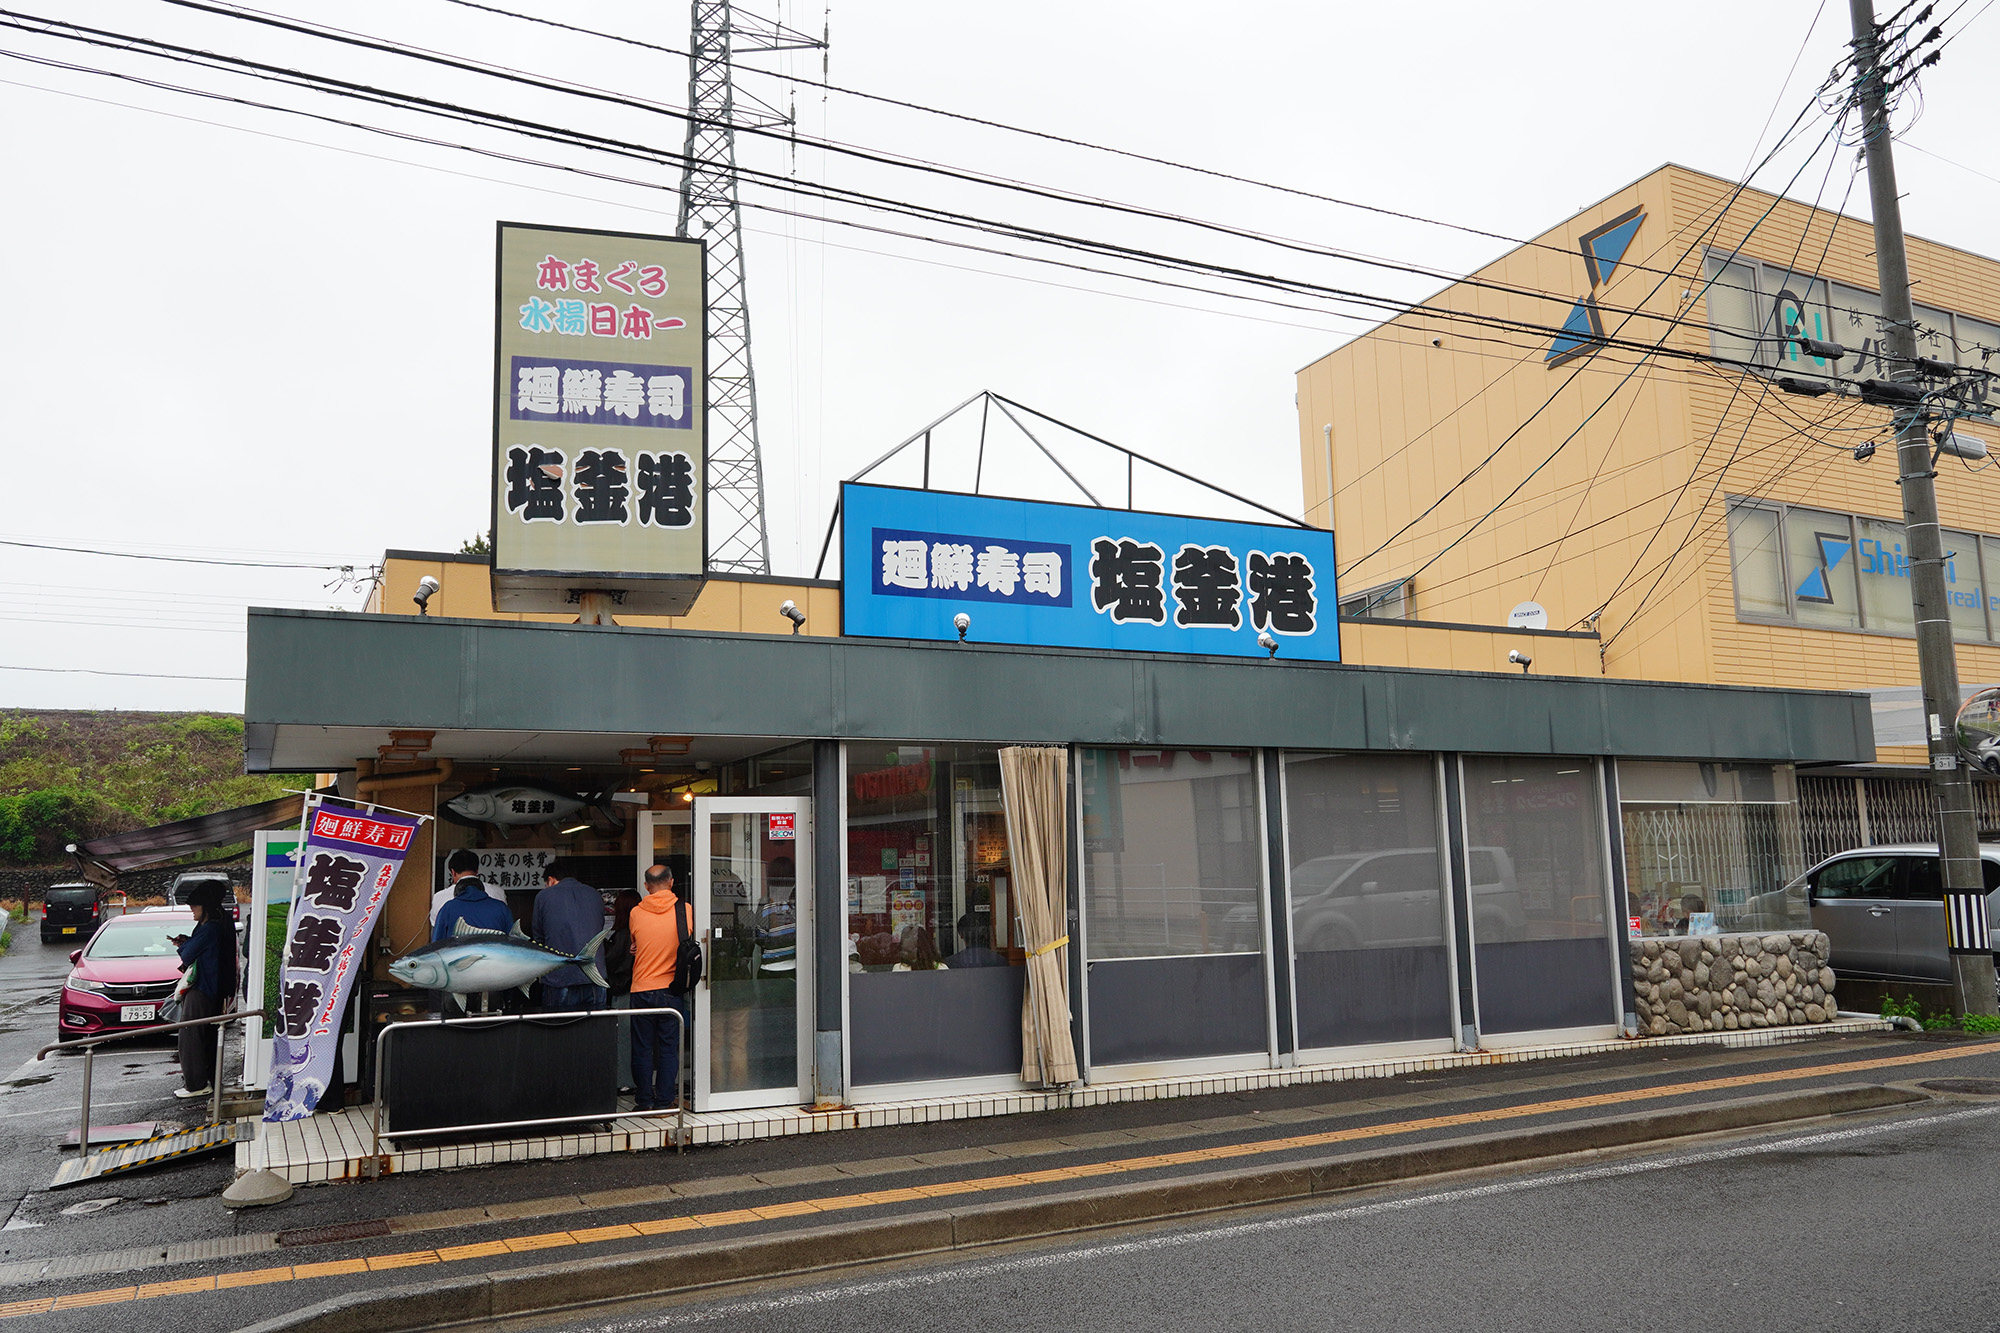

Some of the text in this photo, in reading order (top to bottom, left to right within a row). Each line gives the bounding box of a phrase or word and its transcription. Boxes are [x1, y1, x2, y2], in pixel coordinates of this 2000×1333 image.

[536, 255, 669, 299] 本まぐろ
[519, 296, 687, 340] 水揚日本一
[517, 366, 685, 420] 廻鮮寿司
[504, 443, 697, 530] 塩釜港
[881, 540, 1063, 598] 廻鮮寿司
[1089, 536, 1319, 636] 塩釜港
[316, 815, 408, 847] 廻鮮寿司
[480, 851, 548, 869] の海の味覚
[129, 1011, 153, 1020] 79-53
